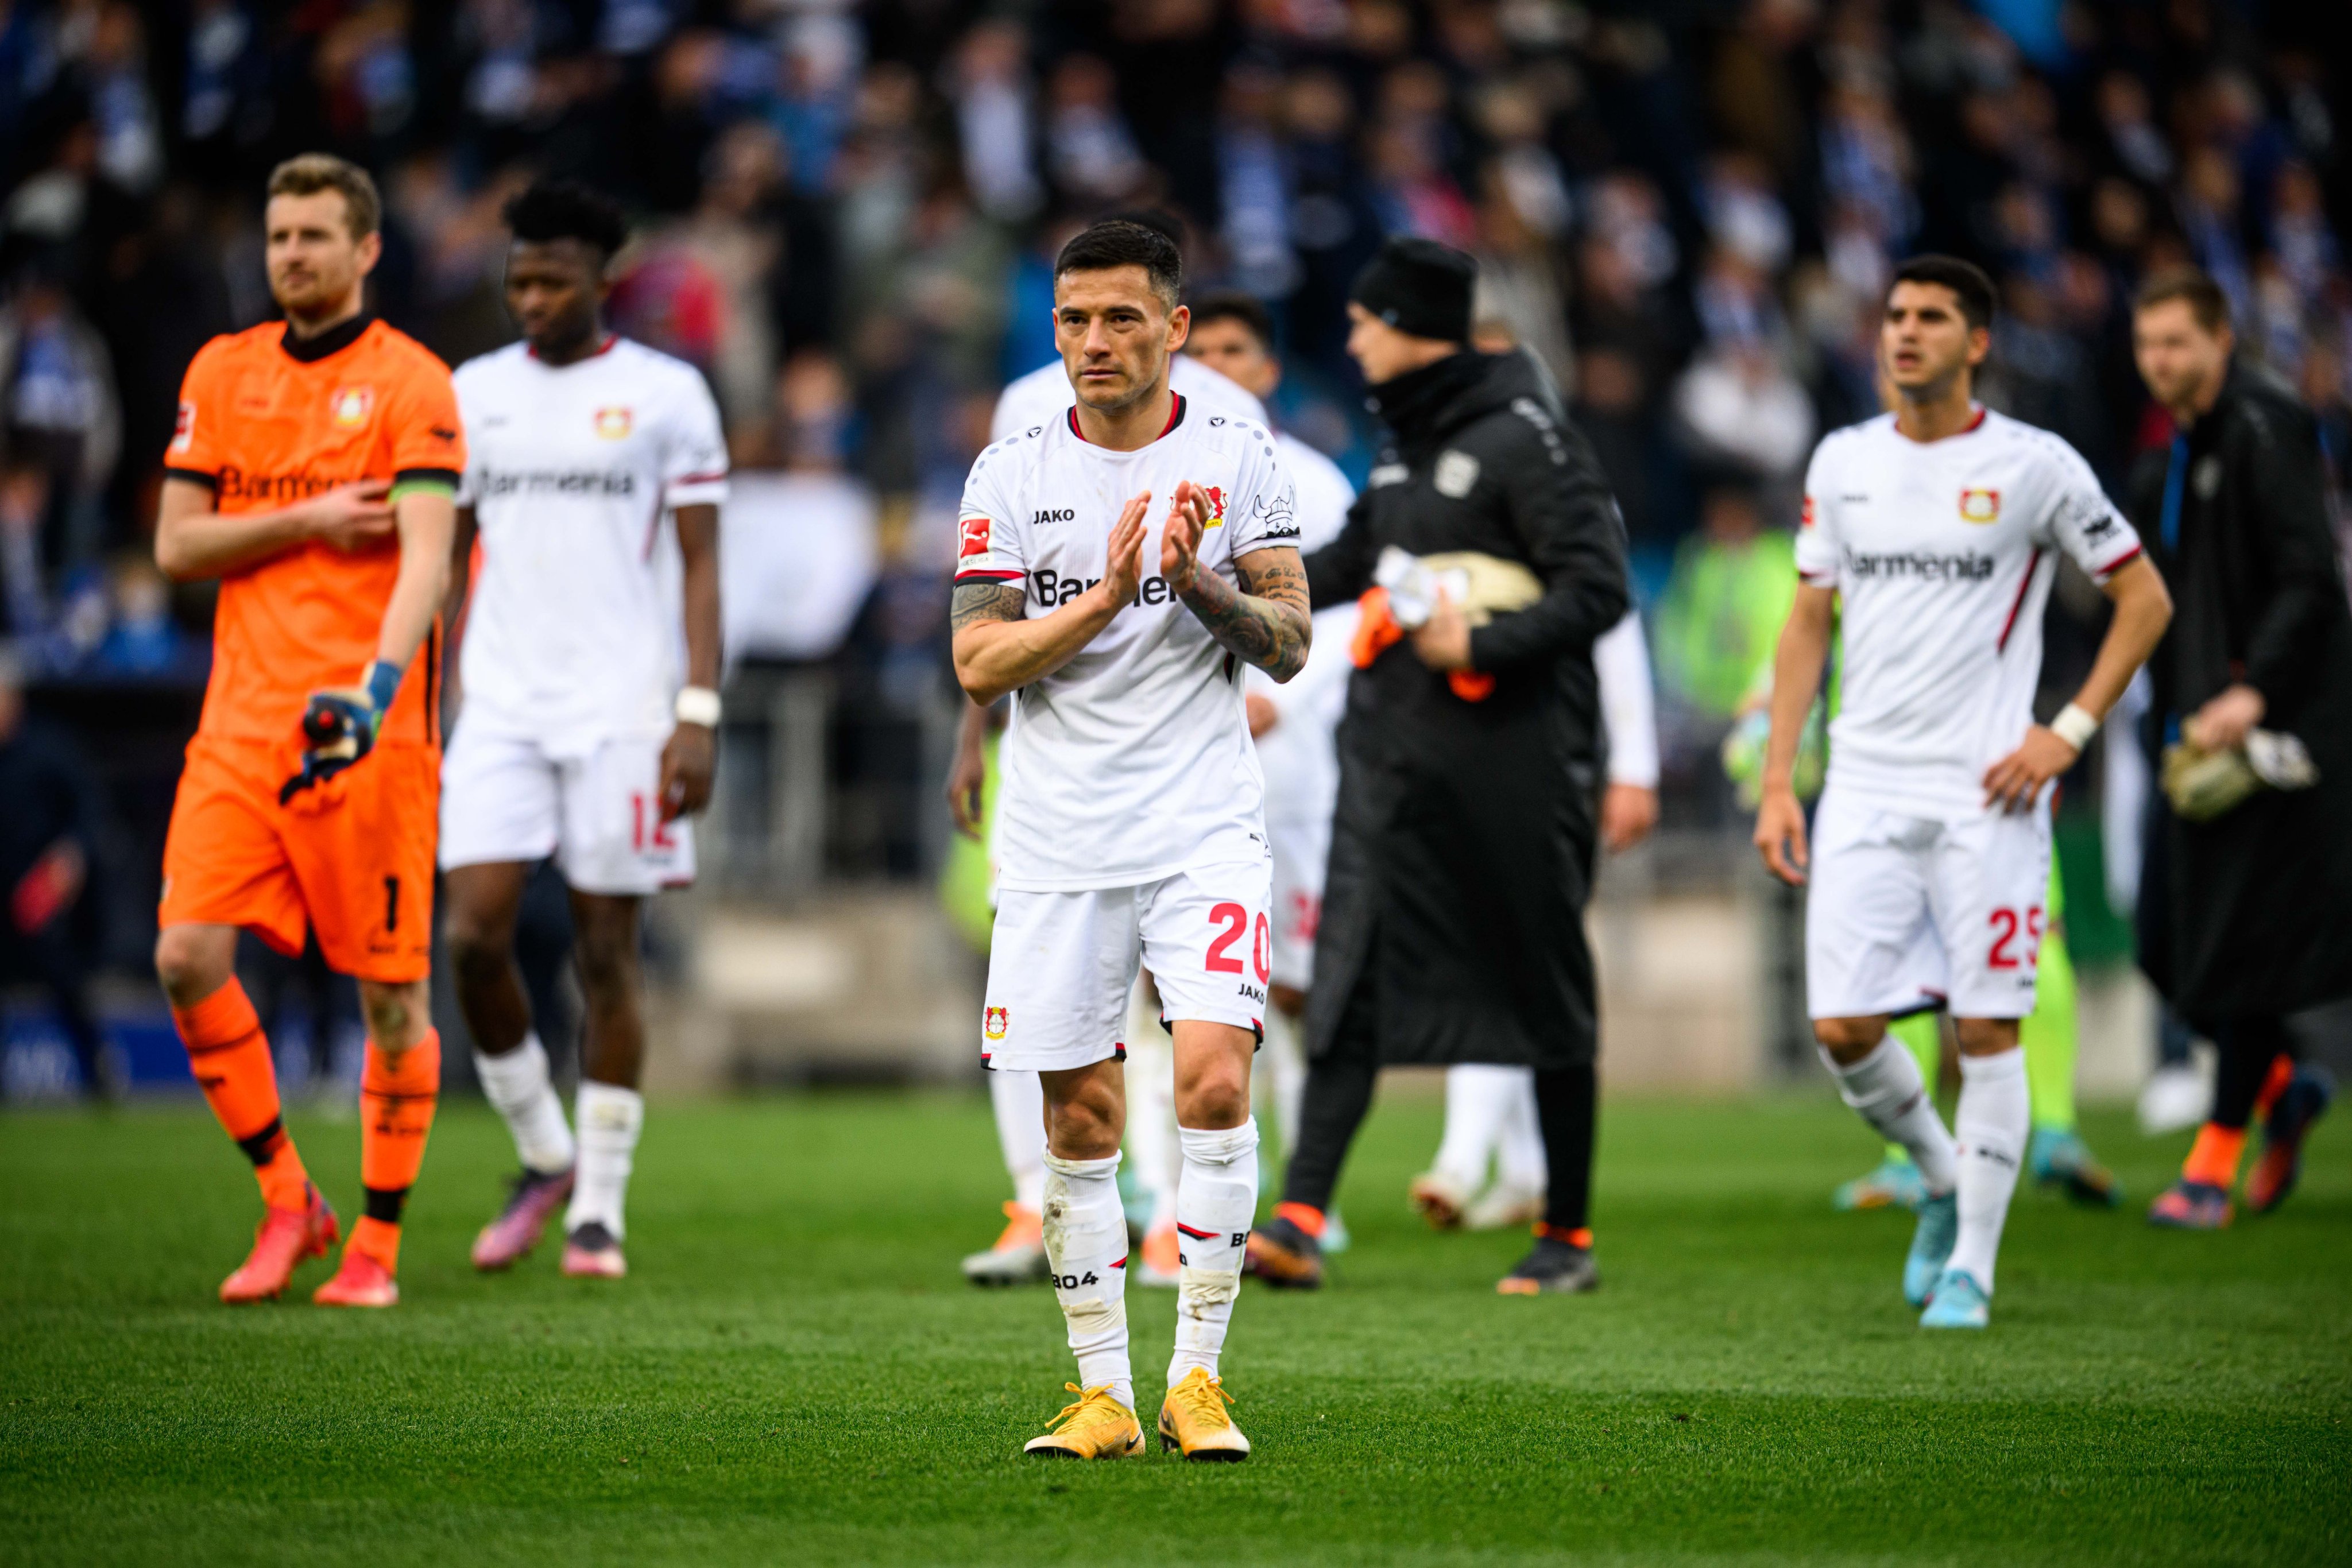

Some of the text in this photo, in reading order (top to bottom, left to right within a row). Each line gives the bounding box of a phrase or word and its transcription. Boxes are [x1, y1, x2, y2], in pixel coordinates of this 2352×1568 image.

[1033, 509, 1075, 525] JAKO
[384, 876, 399, 932] 1
[1205, 902, 1270, 986] 20
